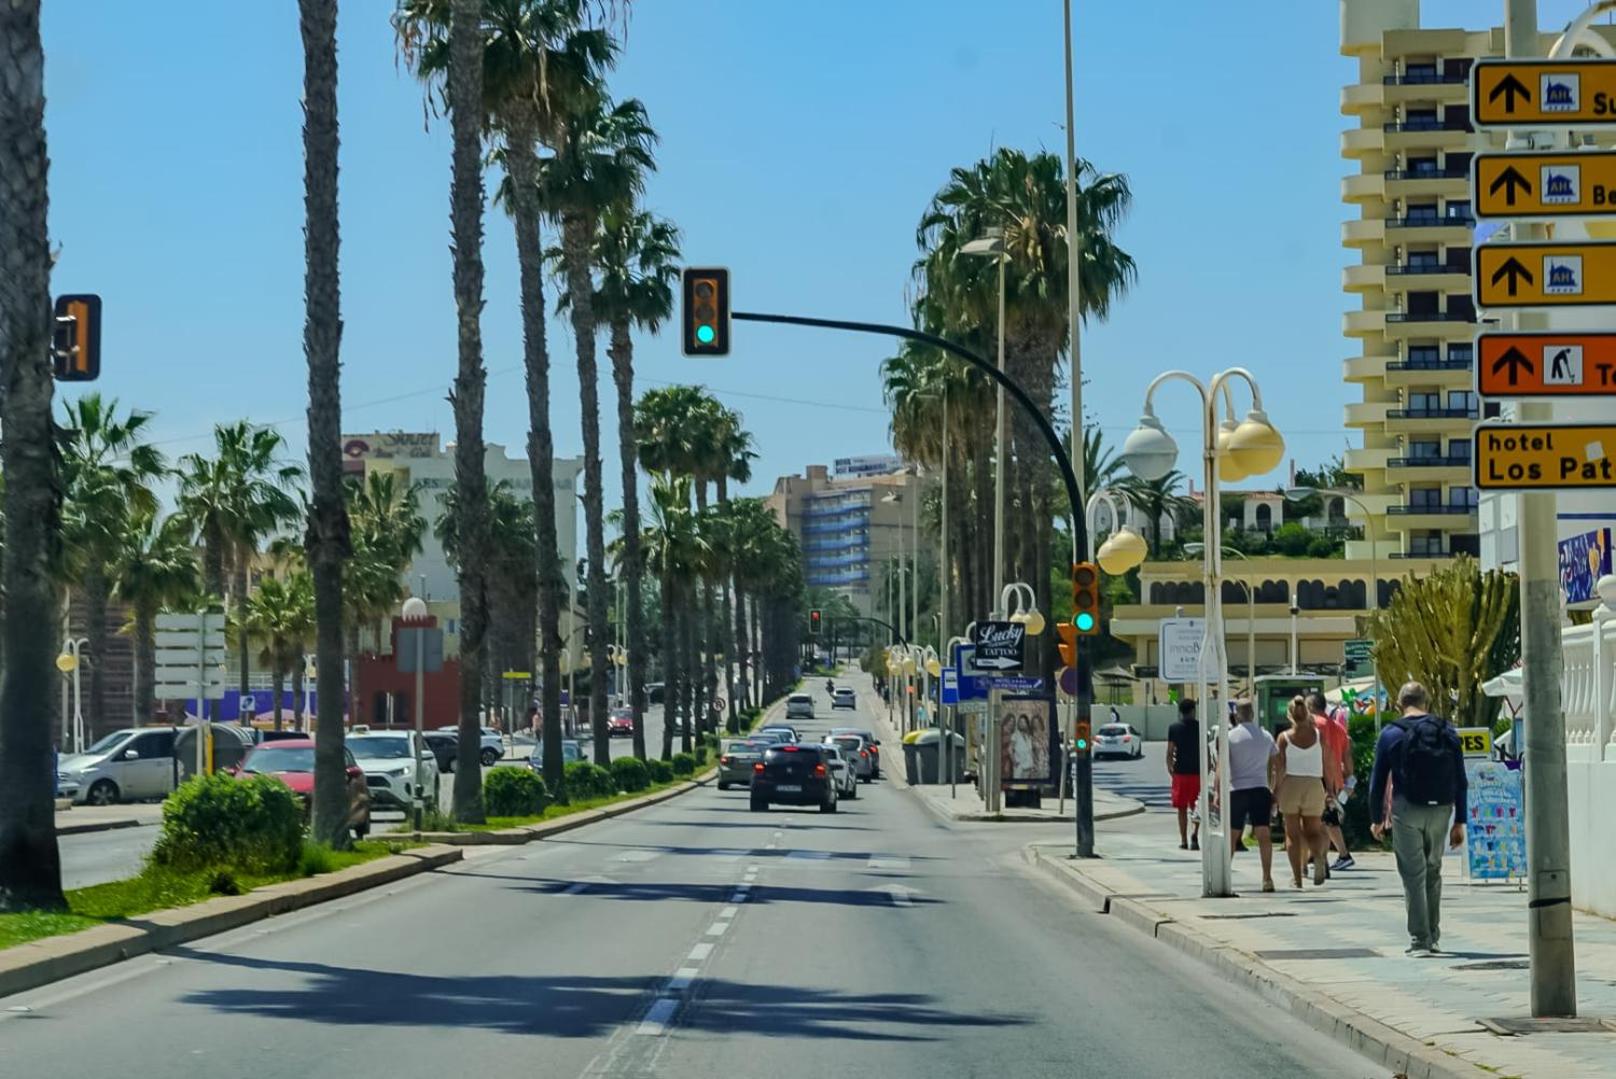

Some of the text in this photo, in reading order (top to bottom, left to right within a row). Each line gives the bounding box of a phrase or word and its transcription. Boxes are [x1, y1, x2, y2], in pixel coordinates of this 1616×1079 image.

[1488, 432, 1553, 451] hotel
[1489, 458, 1541, 480] Los
[979, 623, 1024, 647] Lucky
[984, 647, 1018, 656] TATTOO
